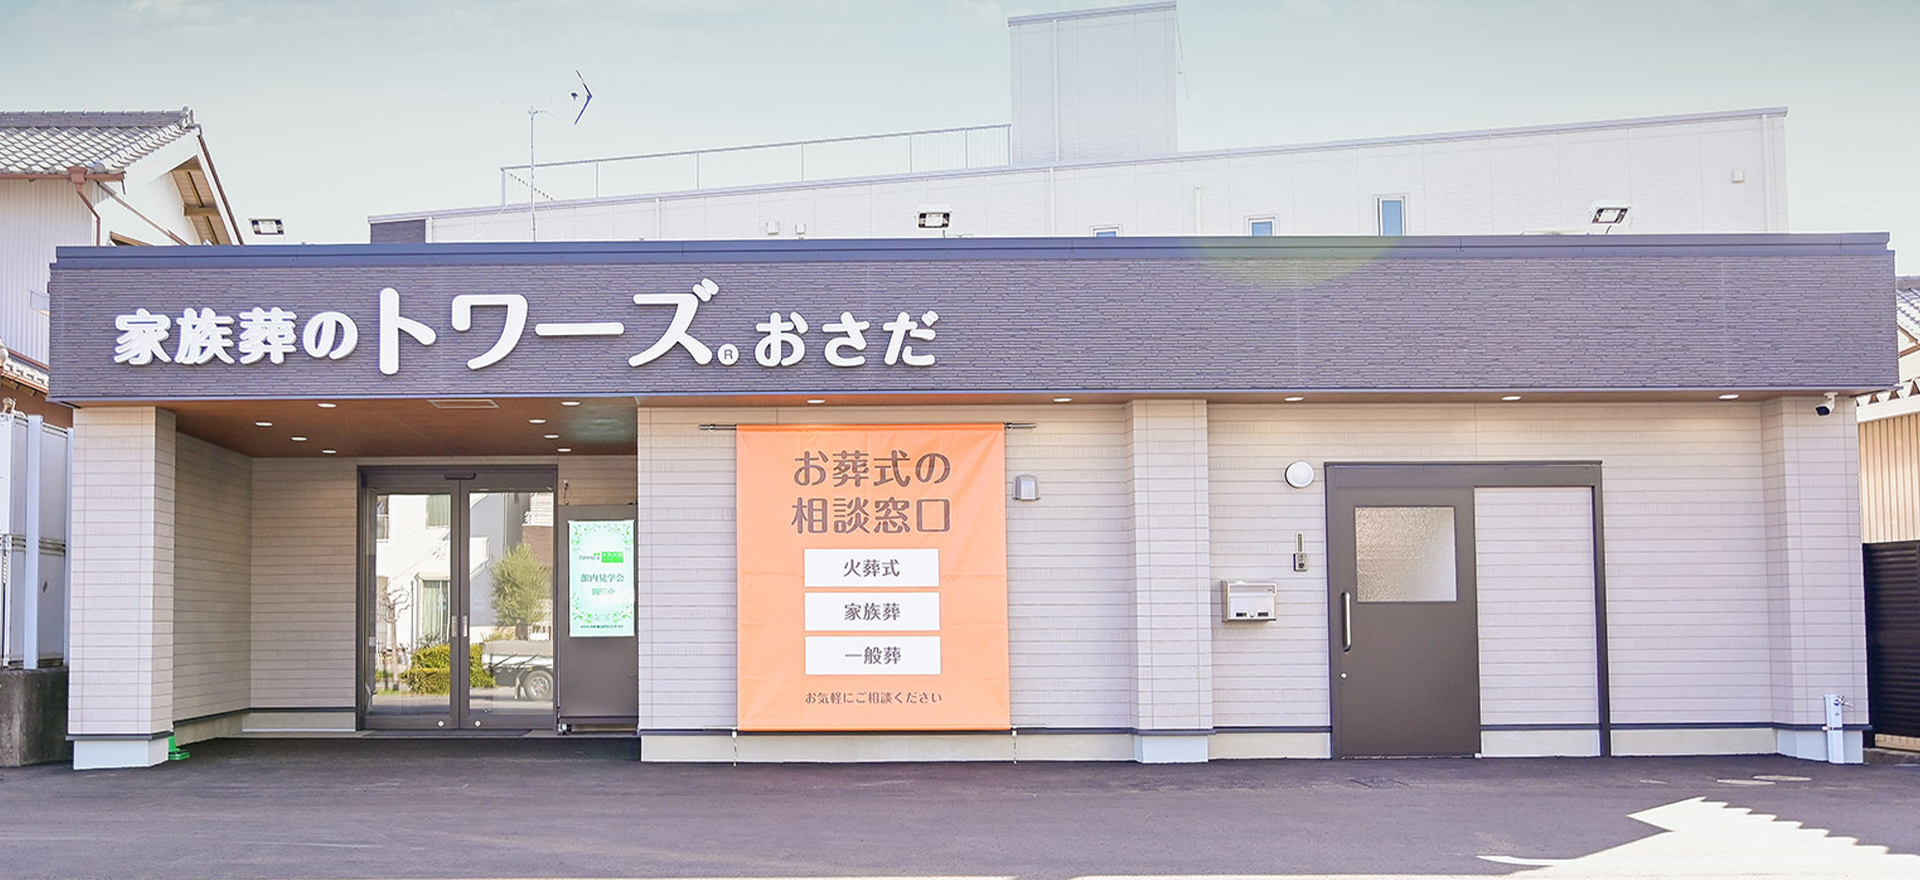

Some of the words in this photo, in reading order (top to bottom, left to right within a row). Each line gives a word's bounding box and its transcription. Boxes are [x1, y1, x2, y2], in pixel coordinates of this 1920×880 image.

[792, 449, 953, 488] お葬式の
[790, 496, 951, 535] 相談窓口
[843, 559, 901, 577] 火葬式
[844, 603, 901, 621] 家族葬
[844, 646, 902, 665] 一般葬
[805, 692, 943, 704] お気軽にご相談ください
